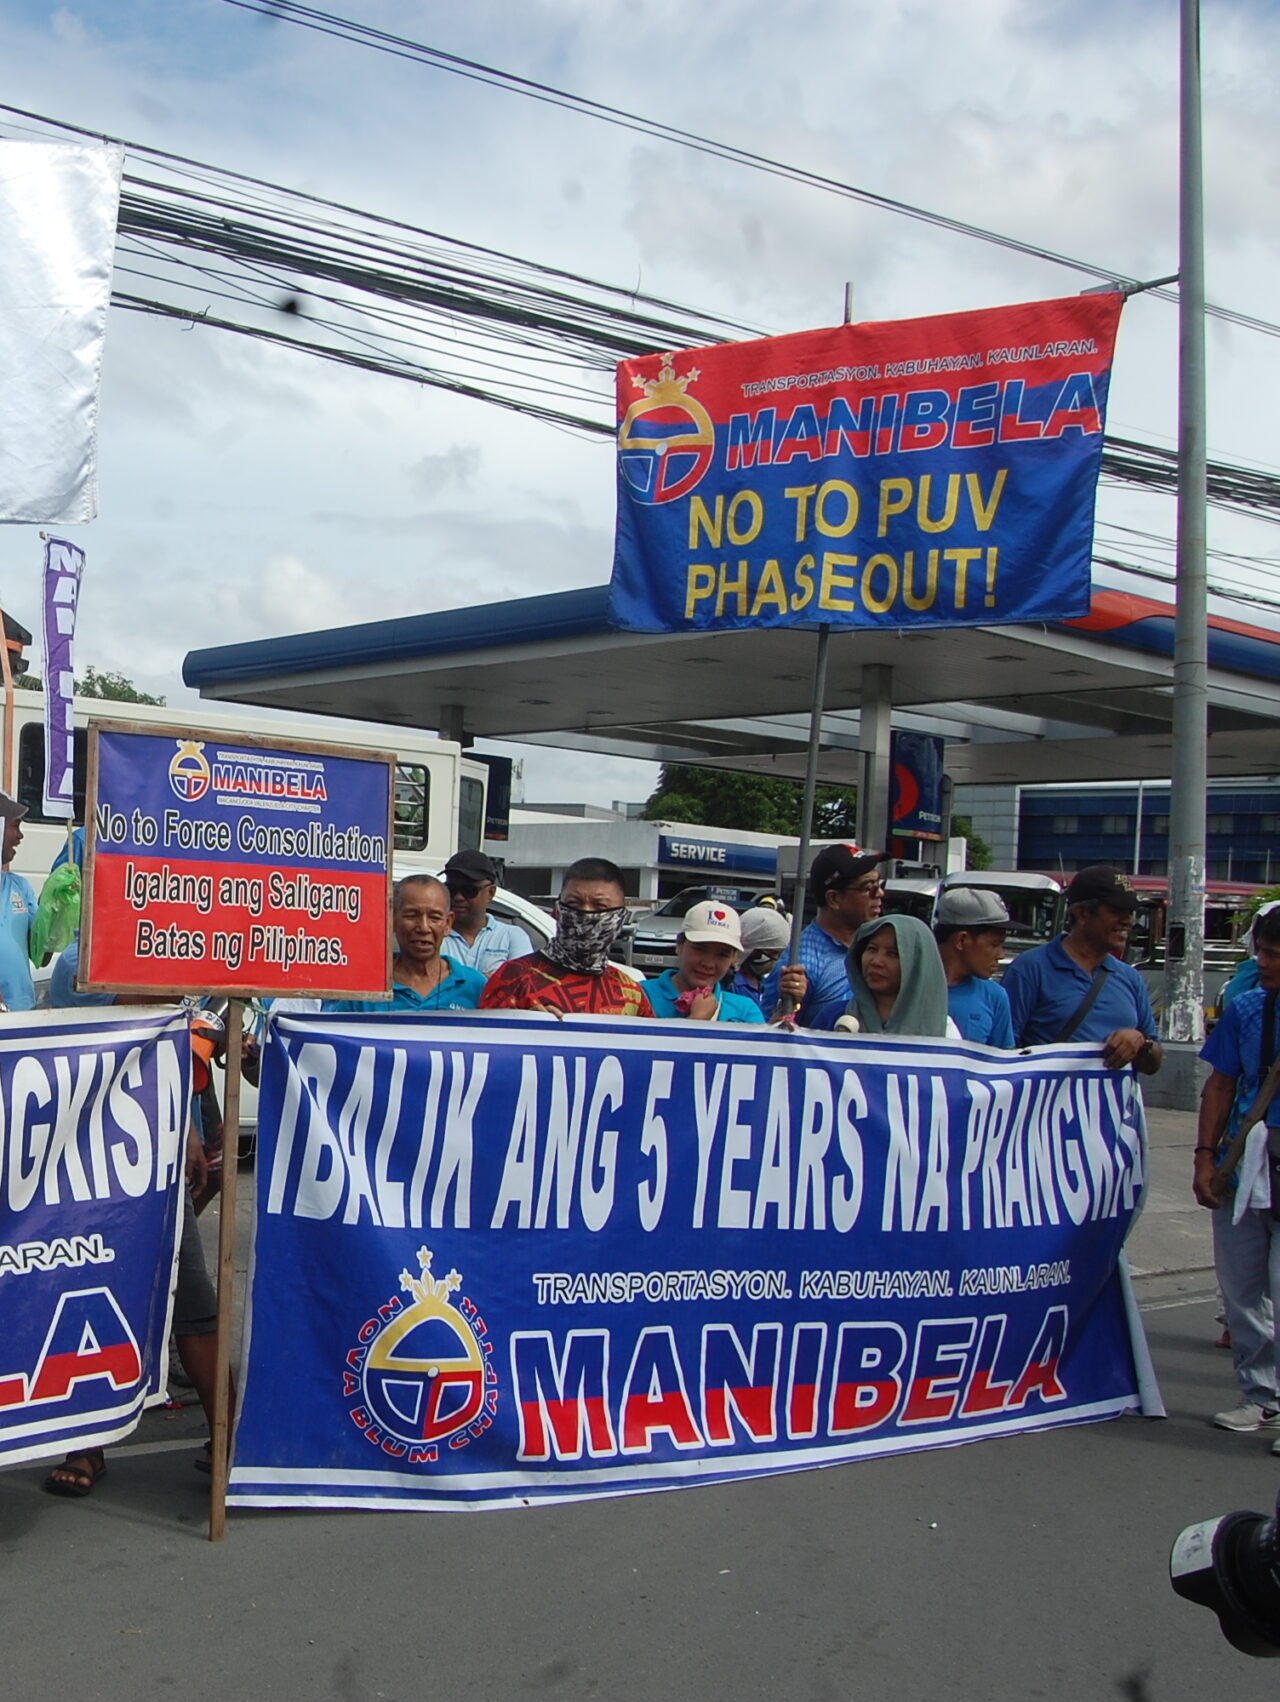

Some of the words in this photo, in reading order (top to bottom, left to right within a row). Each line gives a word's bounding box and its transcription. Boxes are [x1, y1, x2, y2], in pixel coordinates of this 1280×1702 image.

[741, 363, 882, 398] TRANSPORTASYON.
[884, 352, 983, 378] KABUHAYAN.
[986, 338, 1098, 366] KAUNLARAN.
[726, 371, 1102, 472] MANIBELA
[688, 490, 764, 550] NO
[784, 479, 860, 543] TO
[876, 468, 1008, 538] PUV
[683, 547, 998, 619] PHASEOUT!
[212, 764, 327, 800] MANIBELA
[95, 803, 127, 845] No
[132, 811, 159, 846] to
[163, 808, 231, 851] Force
[670, 842, 726, 863] SERVICE
[125, 862, 213, 914] Igalang
[218, 878, 263, 916] ang
[268, 873, 361, 923] Saligang
[135, 920, 205, 960] Batas
[212, 931, 243, 969] ng
[248, 924, 348, 972] Pilipinas.
[490, 1052, 624, 1232] ANG
[637, 1060, 675, 1232] 5
[690, 1060, 870, 1234] YEARS
[880, 1072, 949, 1234] NA
[533, 1270, 793, 1305] TRANSPORTASYON.
[798, 1268, 954, 1300] KABUHAYAN.
[958, 1260, 1071, 1297] KAUNLARAN.
[343, 1296, 404, 1396] NOVA
[448, 1296, 497, 1450] CHAPTER
[509, 1305, 1069, 1462] MANIBELA
[350, 1405, 439, 1463] BLUM
